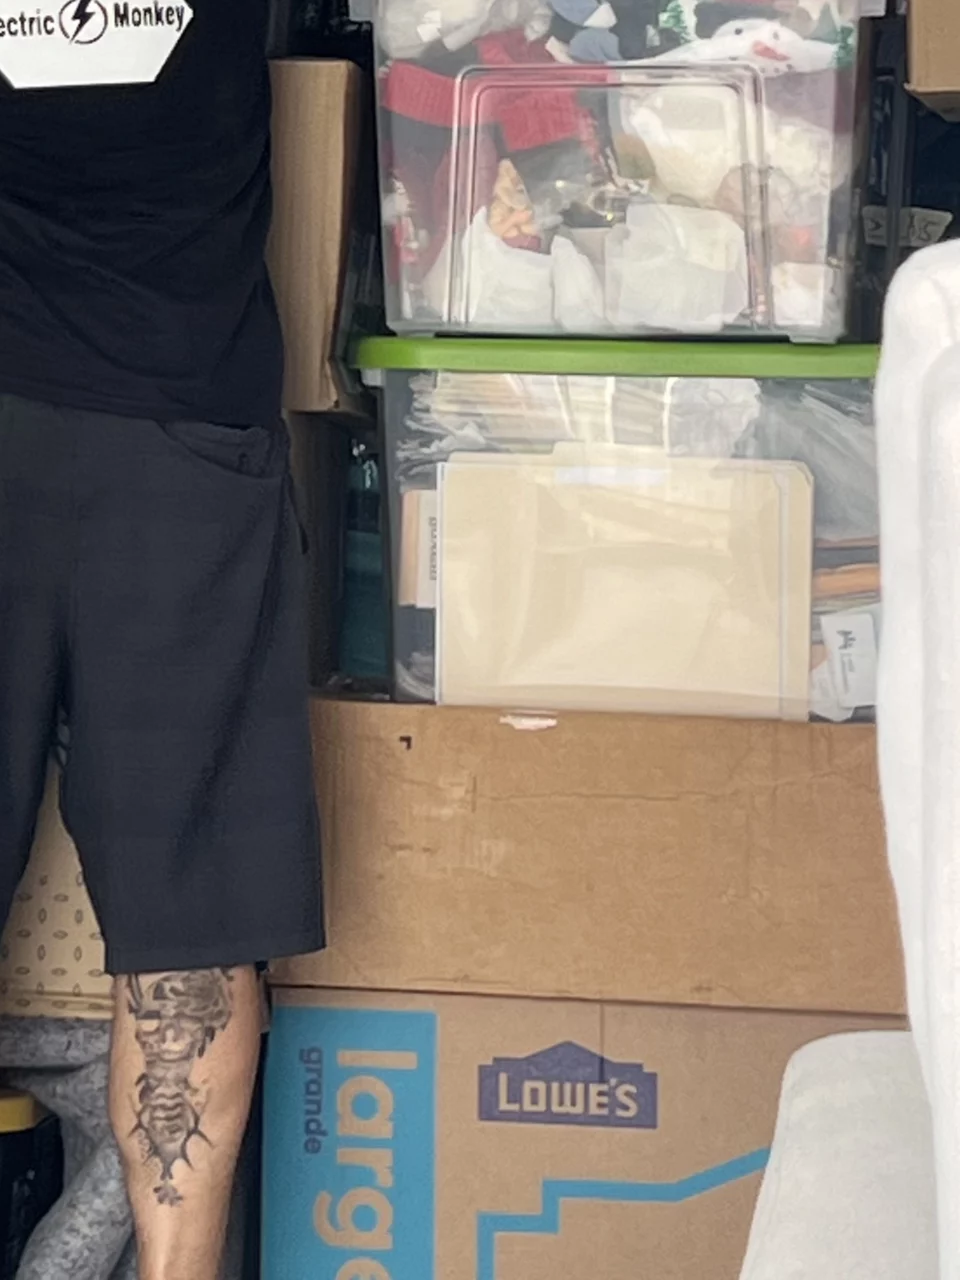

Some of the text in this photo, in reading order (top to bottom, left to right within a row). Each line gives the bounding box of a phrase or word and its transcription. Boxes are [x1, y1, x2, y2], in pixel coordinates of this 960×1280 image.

[113, 0, 185, 32] Monkey
[298, 1047, 328, 1154] grande
[498, 1071, 640, 1119] LOWE'S
